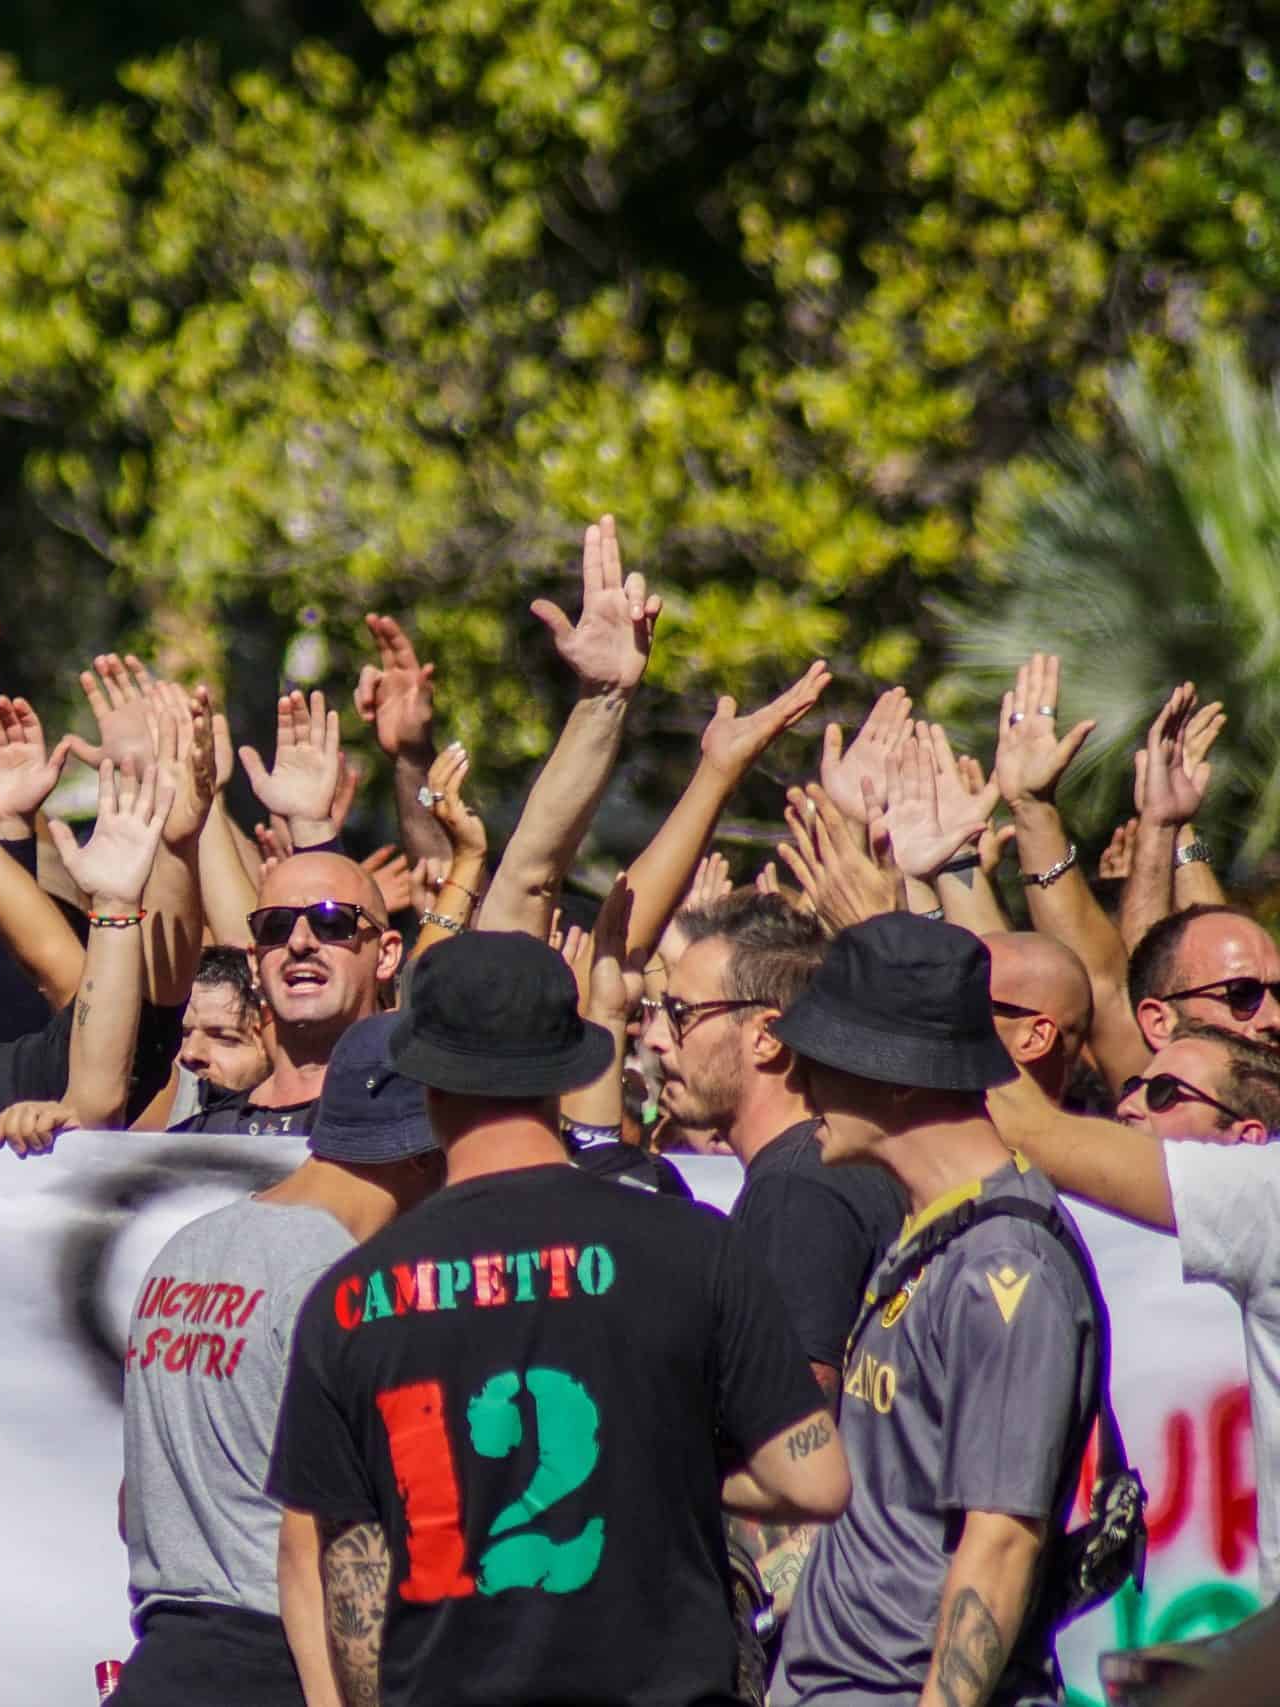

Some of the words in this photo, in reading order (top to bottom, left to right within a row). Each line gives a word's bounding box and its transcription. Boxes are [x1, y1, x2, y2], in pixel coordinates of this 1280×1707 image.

[333, 1244, 616, 1331] CAMPETTO
[785, 1419, 832, 1462] 1925
[375, 1367, 605, 1604] 12
